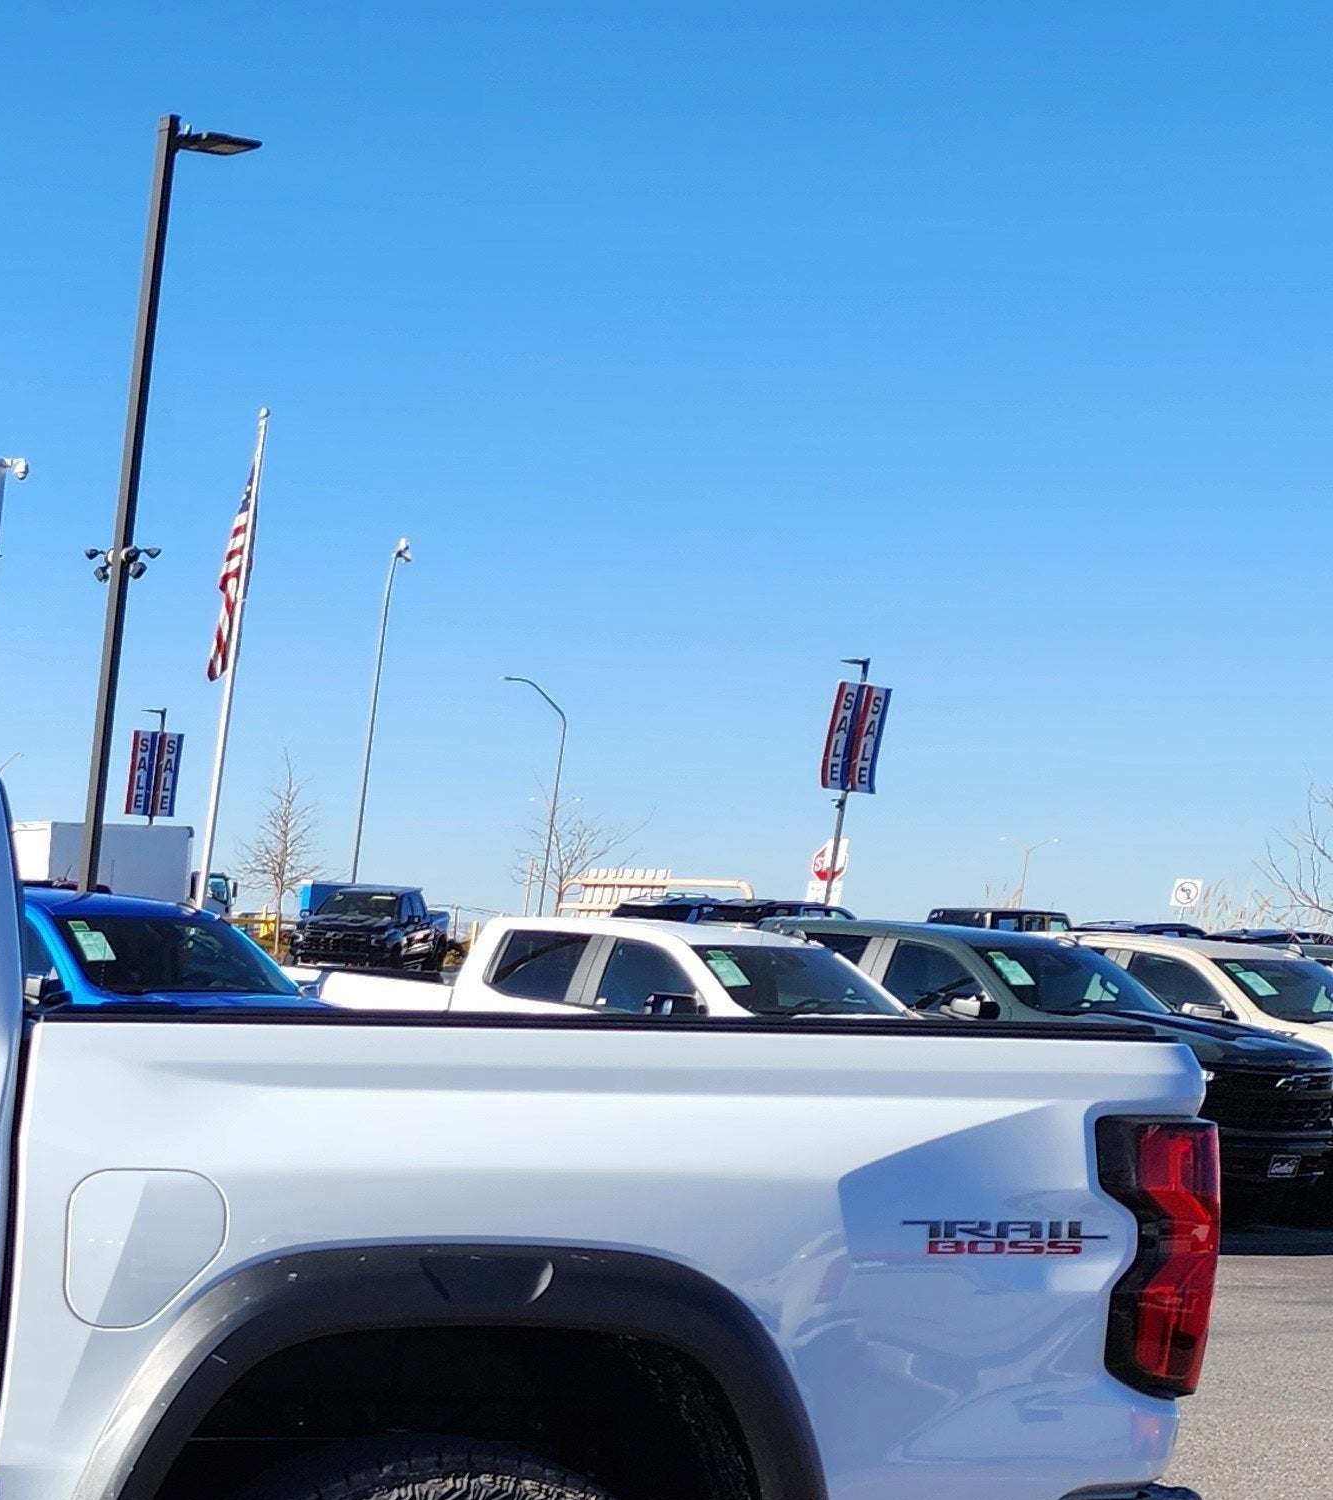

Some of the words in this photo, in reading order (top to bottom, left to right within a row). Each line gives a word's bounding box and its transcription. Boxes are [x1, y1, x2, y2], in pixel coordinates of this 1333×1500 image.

[830, 692, 854, 782] SALE
[858, 696, 882, 784] SALE
[133, 738, 149, 808] SALE
[160, 740, 176, 810] SALE
[901, 1220, 1109, 1240] TRAIL
[927, 1240, 1083, 1255] BOSS
